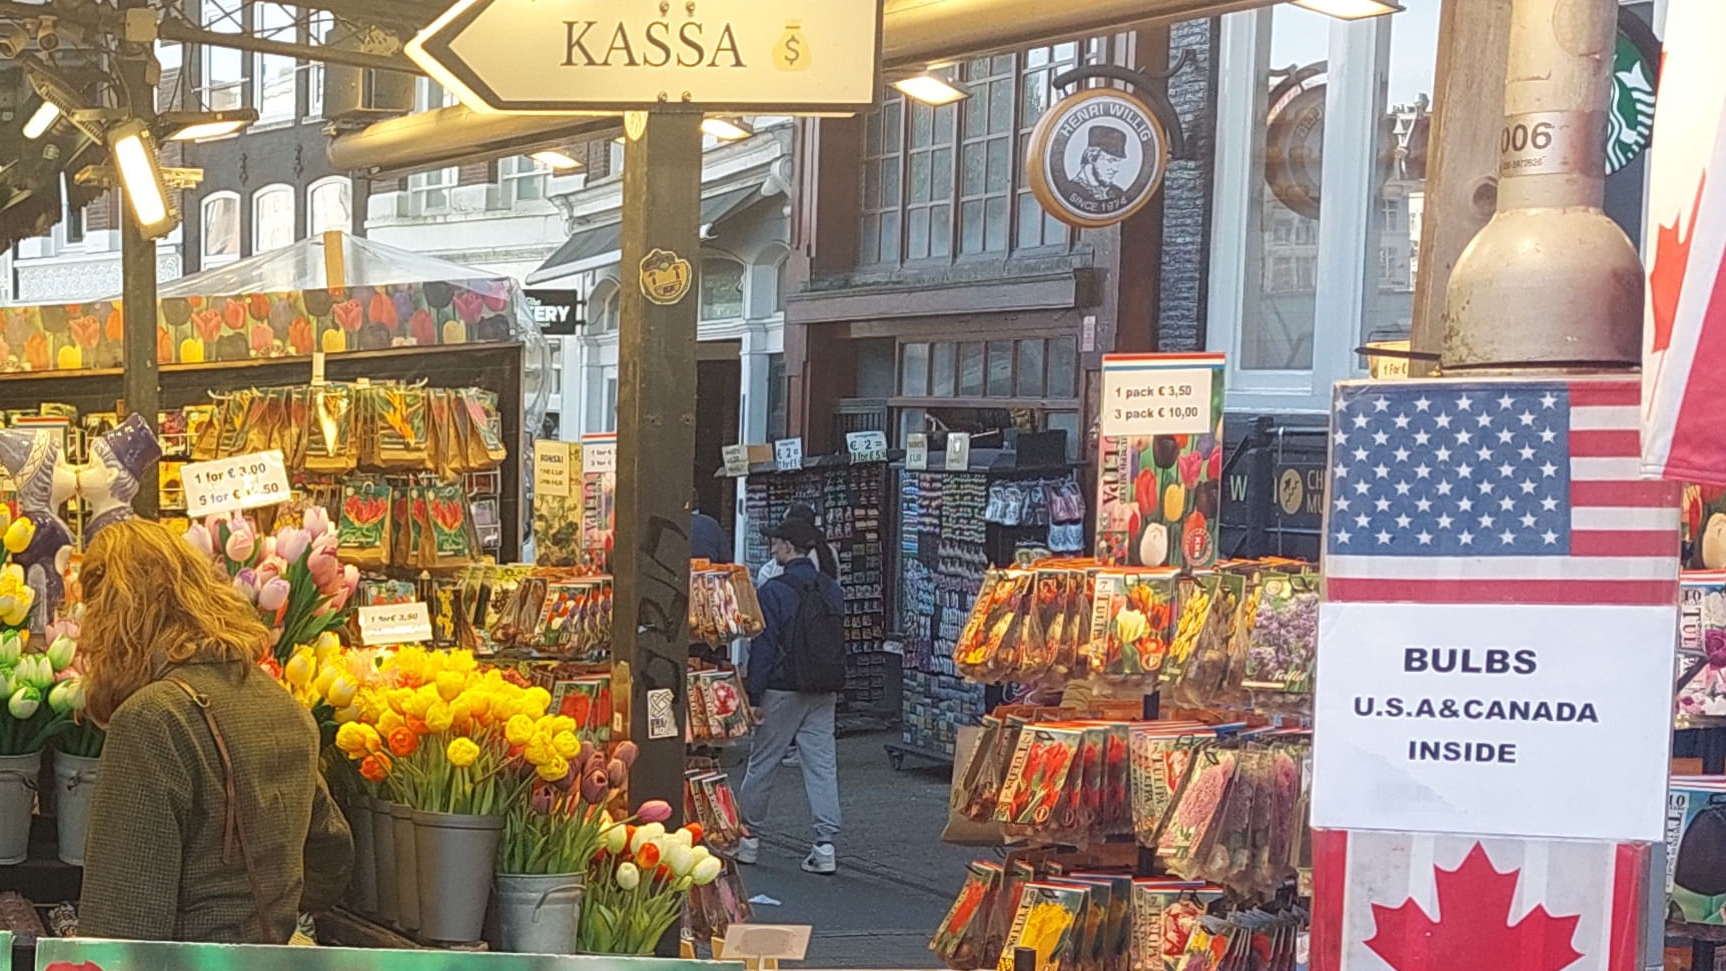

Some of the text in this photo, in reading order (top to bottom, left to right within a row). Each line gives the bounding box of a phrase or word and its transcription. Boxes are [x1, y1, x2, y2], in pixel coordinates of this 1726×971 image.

[561, 20, 747, 68] KASSA
[1060, 103, 1152, 143] HENRI WILLIG
[1069, 192, 1099, 211] SINCE
[1115, 385, 1192, 400] 1 pack € 3,50
[1115, 407, 1198, 421] 3 pack € 10,00
[864, 440, 871, 450] 2
[195, 462, 267, 485] 1 for € 3.00
[199, 489, 241, 506] 5 for €
[1404, 648, 1537, 675] BULBS
[1354, 697, 1599, 723] U.S.A&CANADA
[1409, 740, 1516, 763] INSIDE
